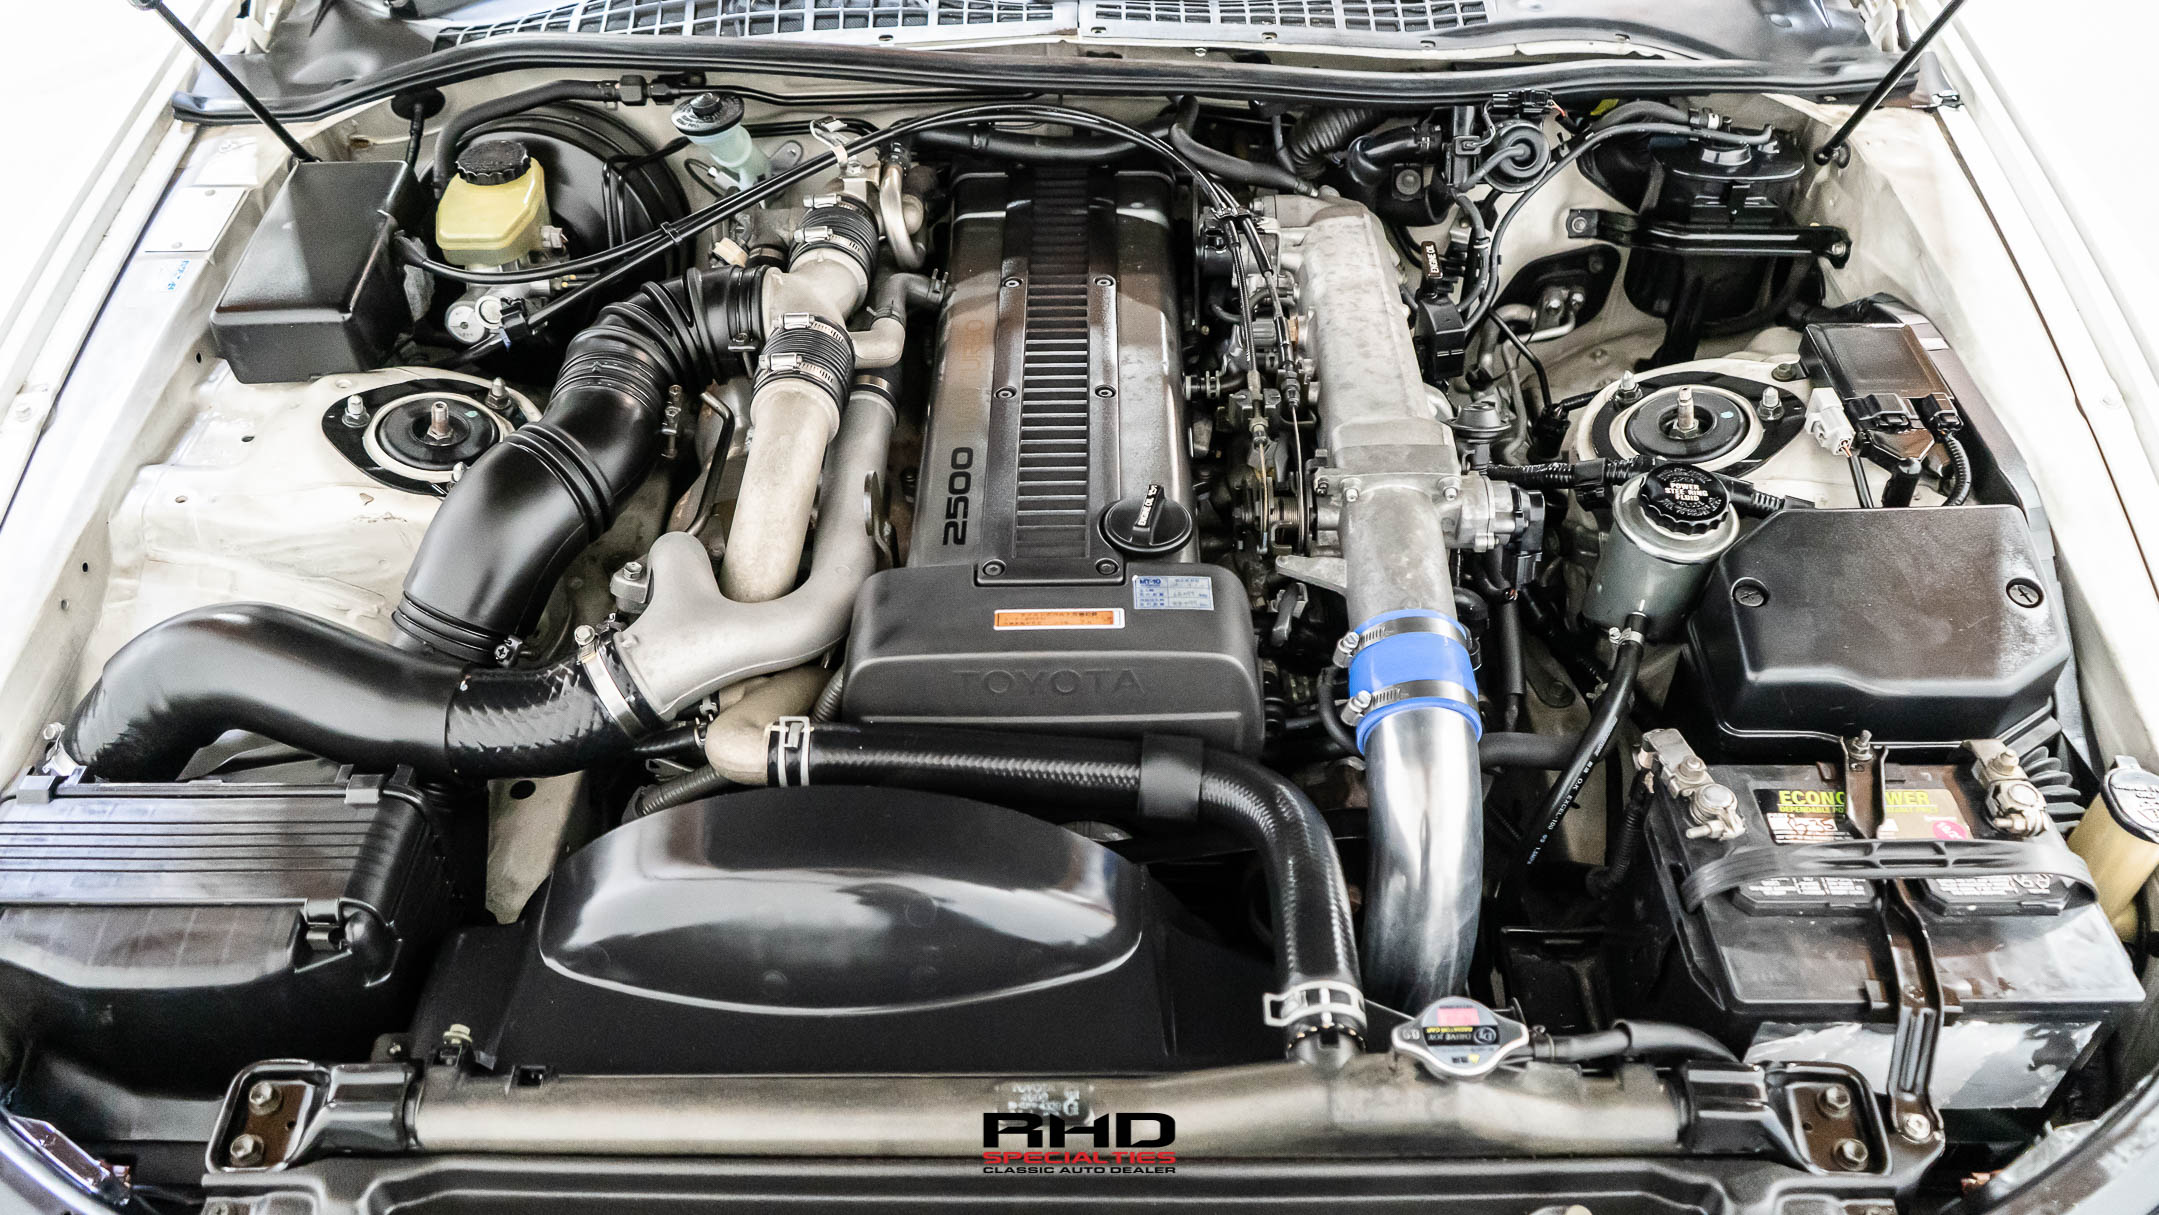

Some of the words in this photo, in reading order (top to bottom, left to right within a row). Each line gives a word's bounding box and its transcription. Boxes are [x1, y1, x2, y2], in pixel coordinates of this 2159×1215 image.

[1669, 482, 1700, 491] POWER
[942, 447, 974, 546] 2500
[1674, 494, 1700, 502] FLUID
[952, 668, 1146, 694] TOYOTA
